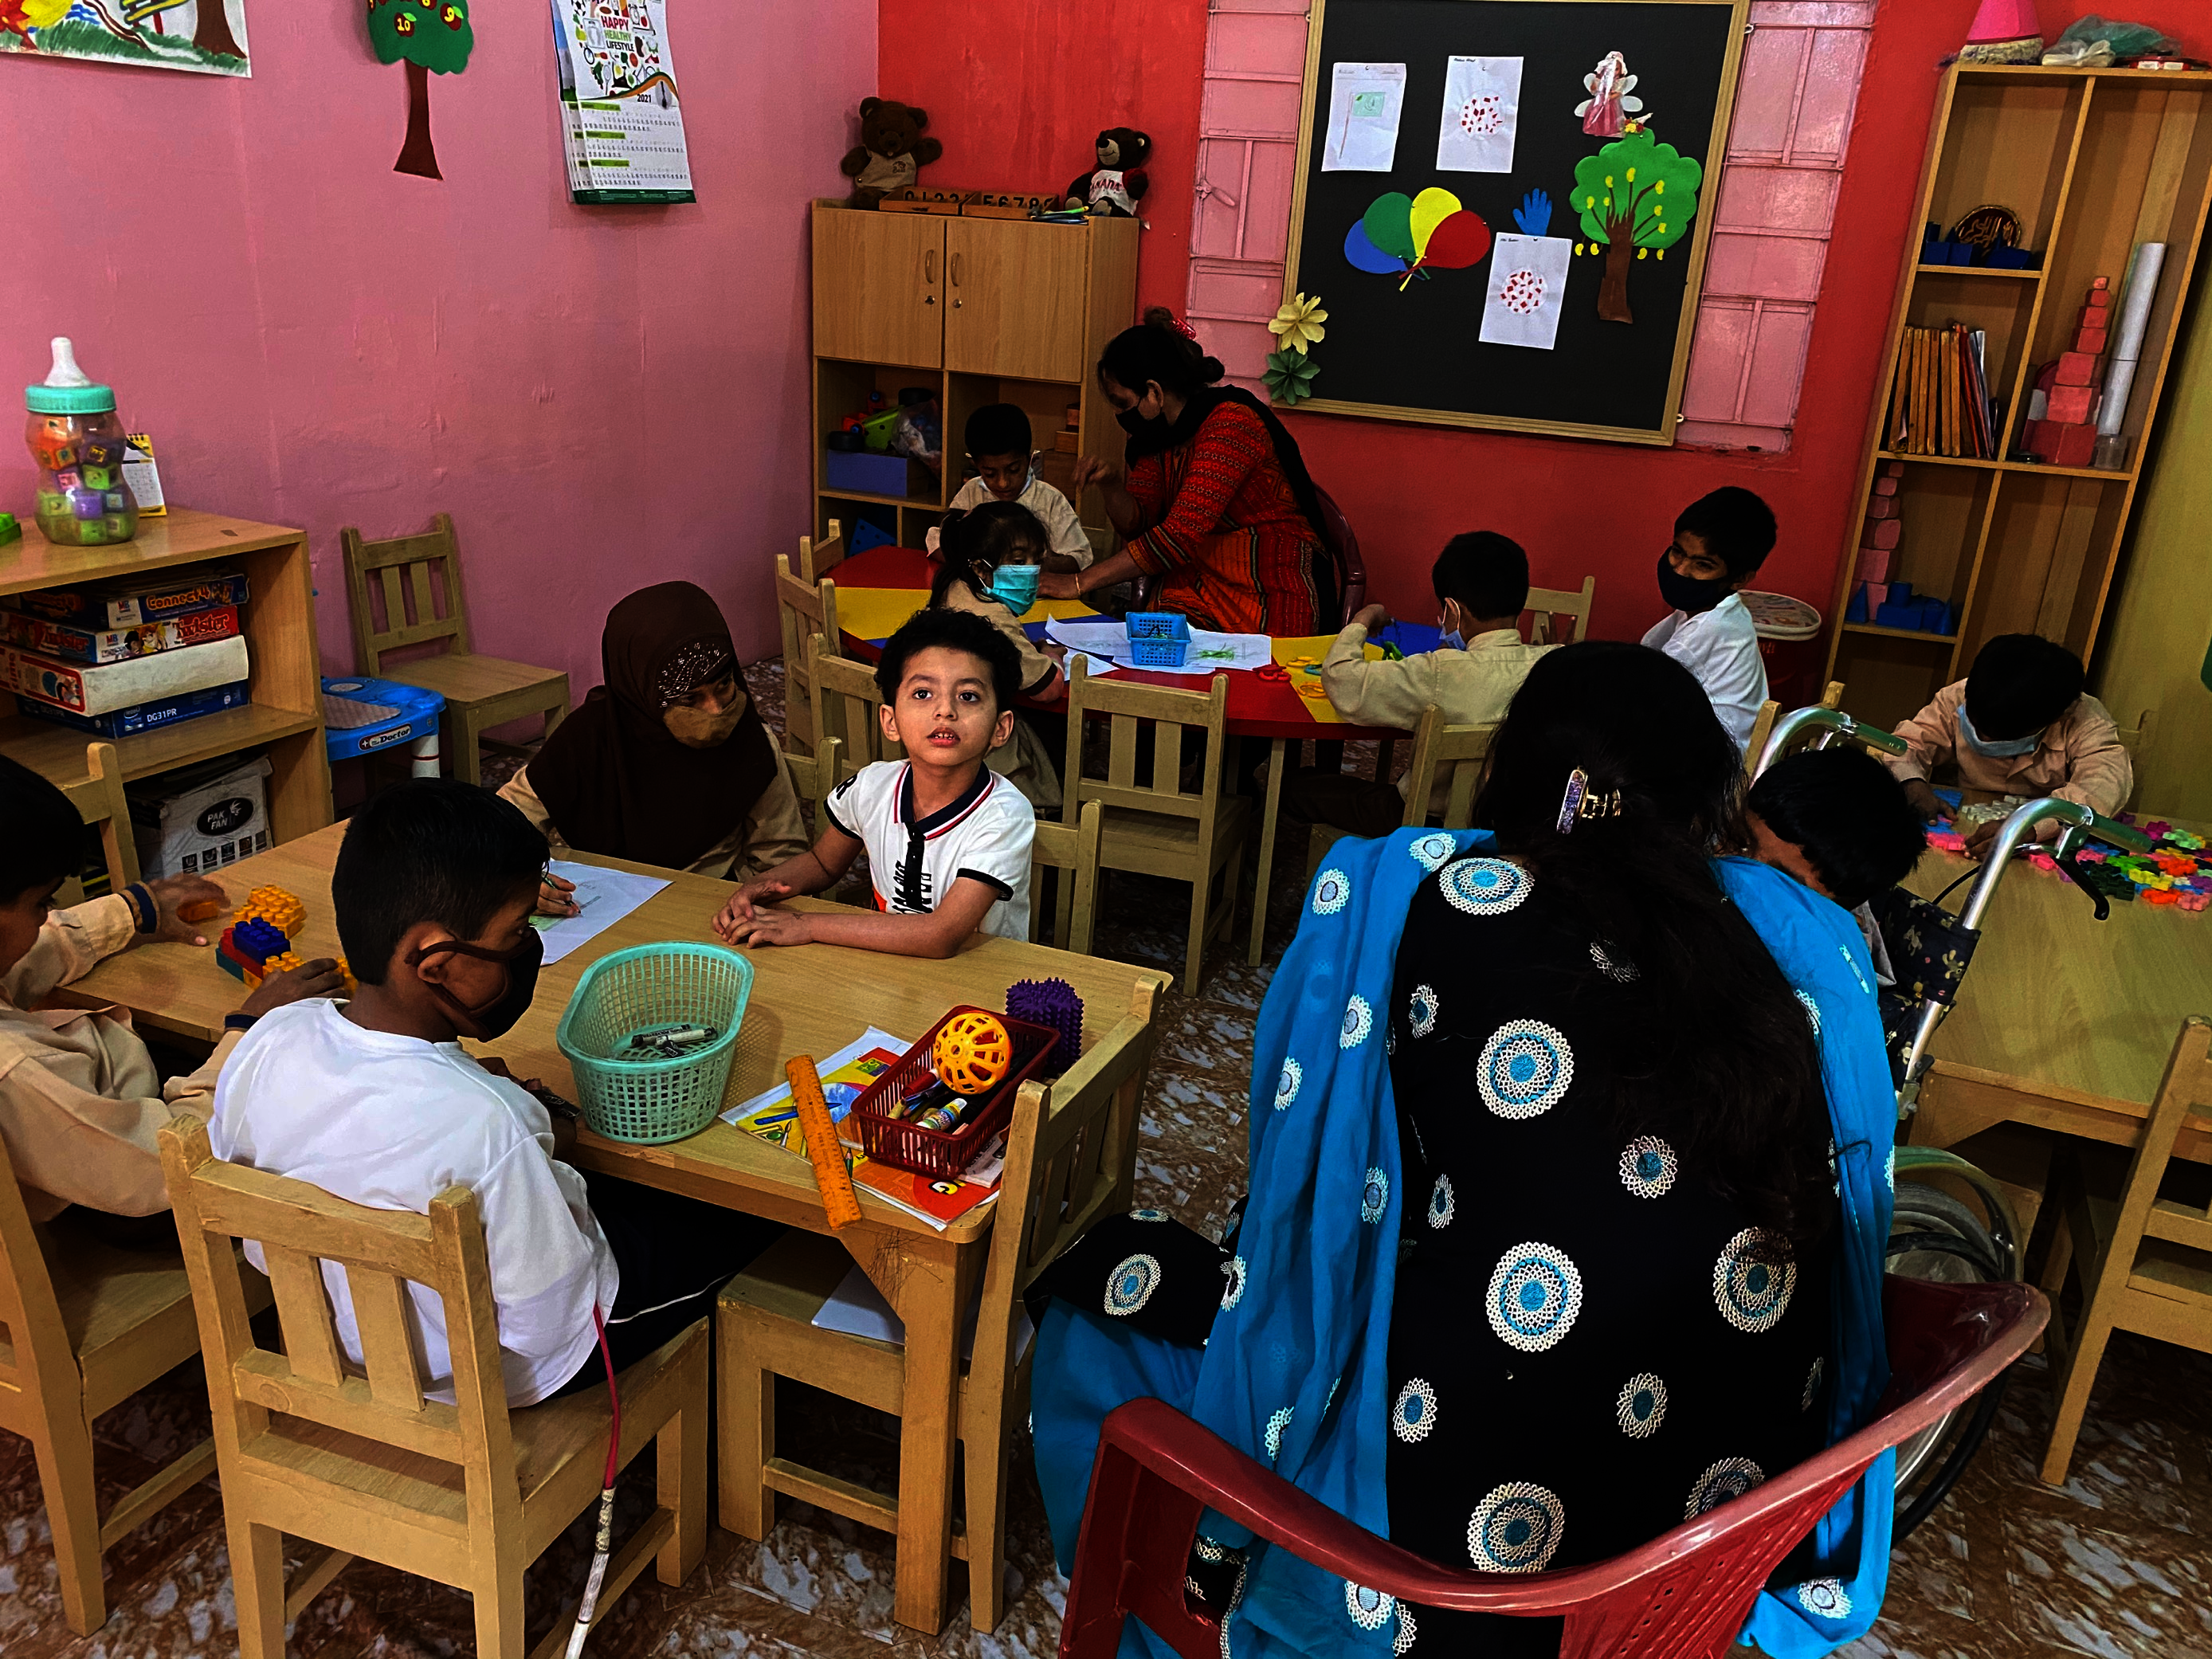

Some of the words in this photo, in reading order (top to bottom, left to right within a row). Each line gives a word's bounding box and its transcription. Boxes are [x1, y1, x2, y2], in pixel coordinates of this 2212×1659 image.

[397, 18, 411, 31] 10
[601, 15, 629, 31] HAPPY
[604, 29, 632, 41] HEALTHY
[606, 40, 635, 53] LIFESTYLE
[637, 93, 652, 104] 2021
[147, 586, 200, 610] Connect
[171, 614, 229, 640] Twister
[106, 633, 119, 645] MB
[147, 708, 178, 723] DG31PR
[379, 728, 410, 743] Doctor
[207, 810, 226, 823] PAK
[210, 818, 229, 830] FAN
